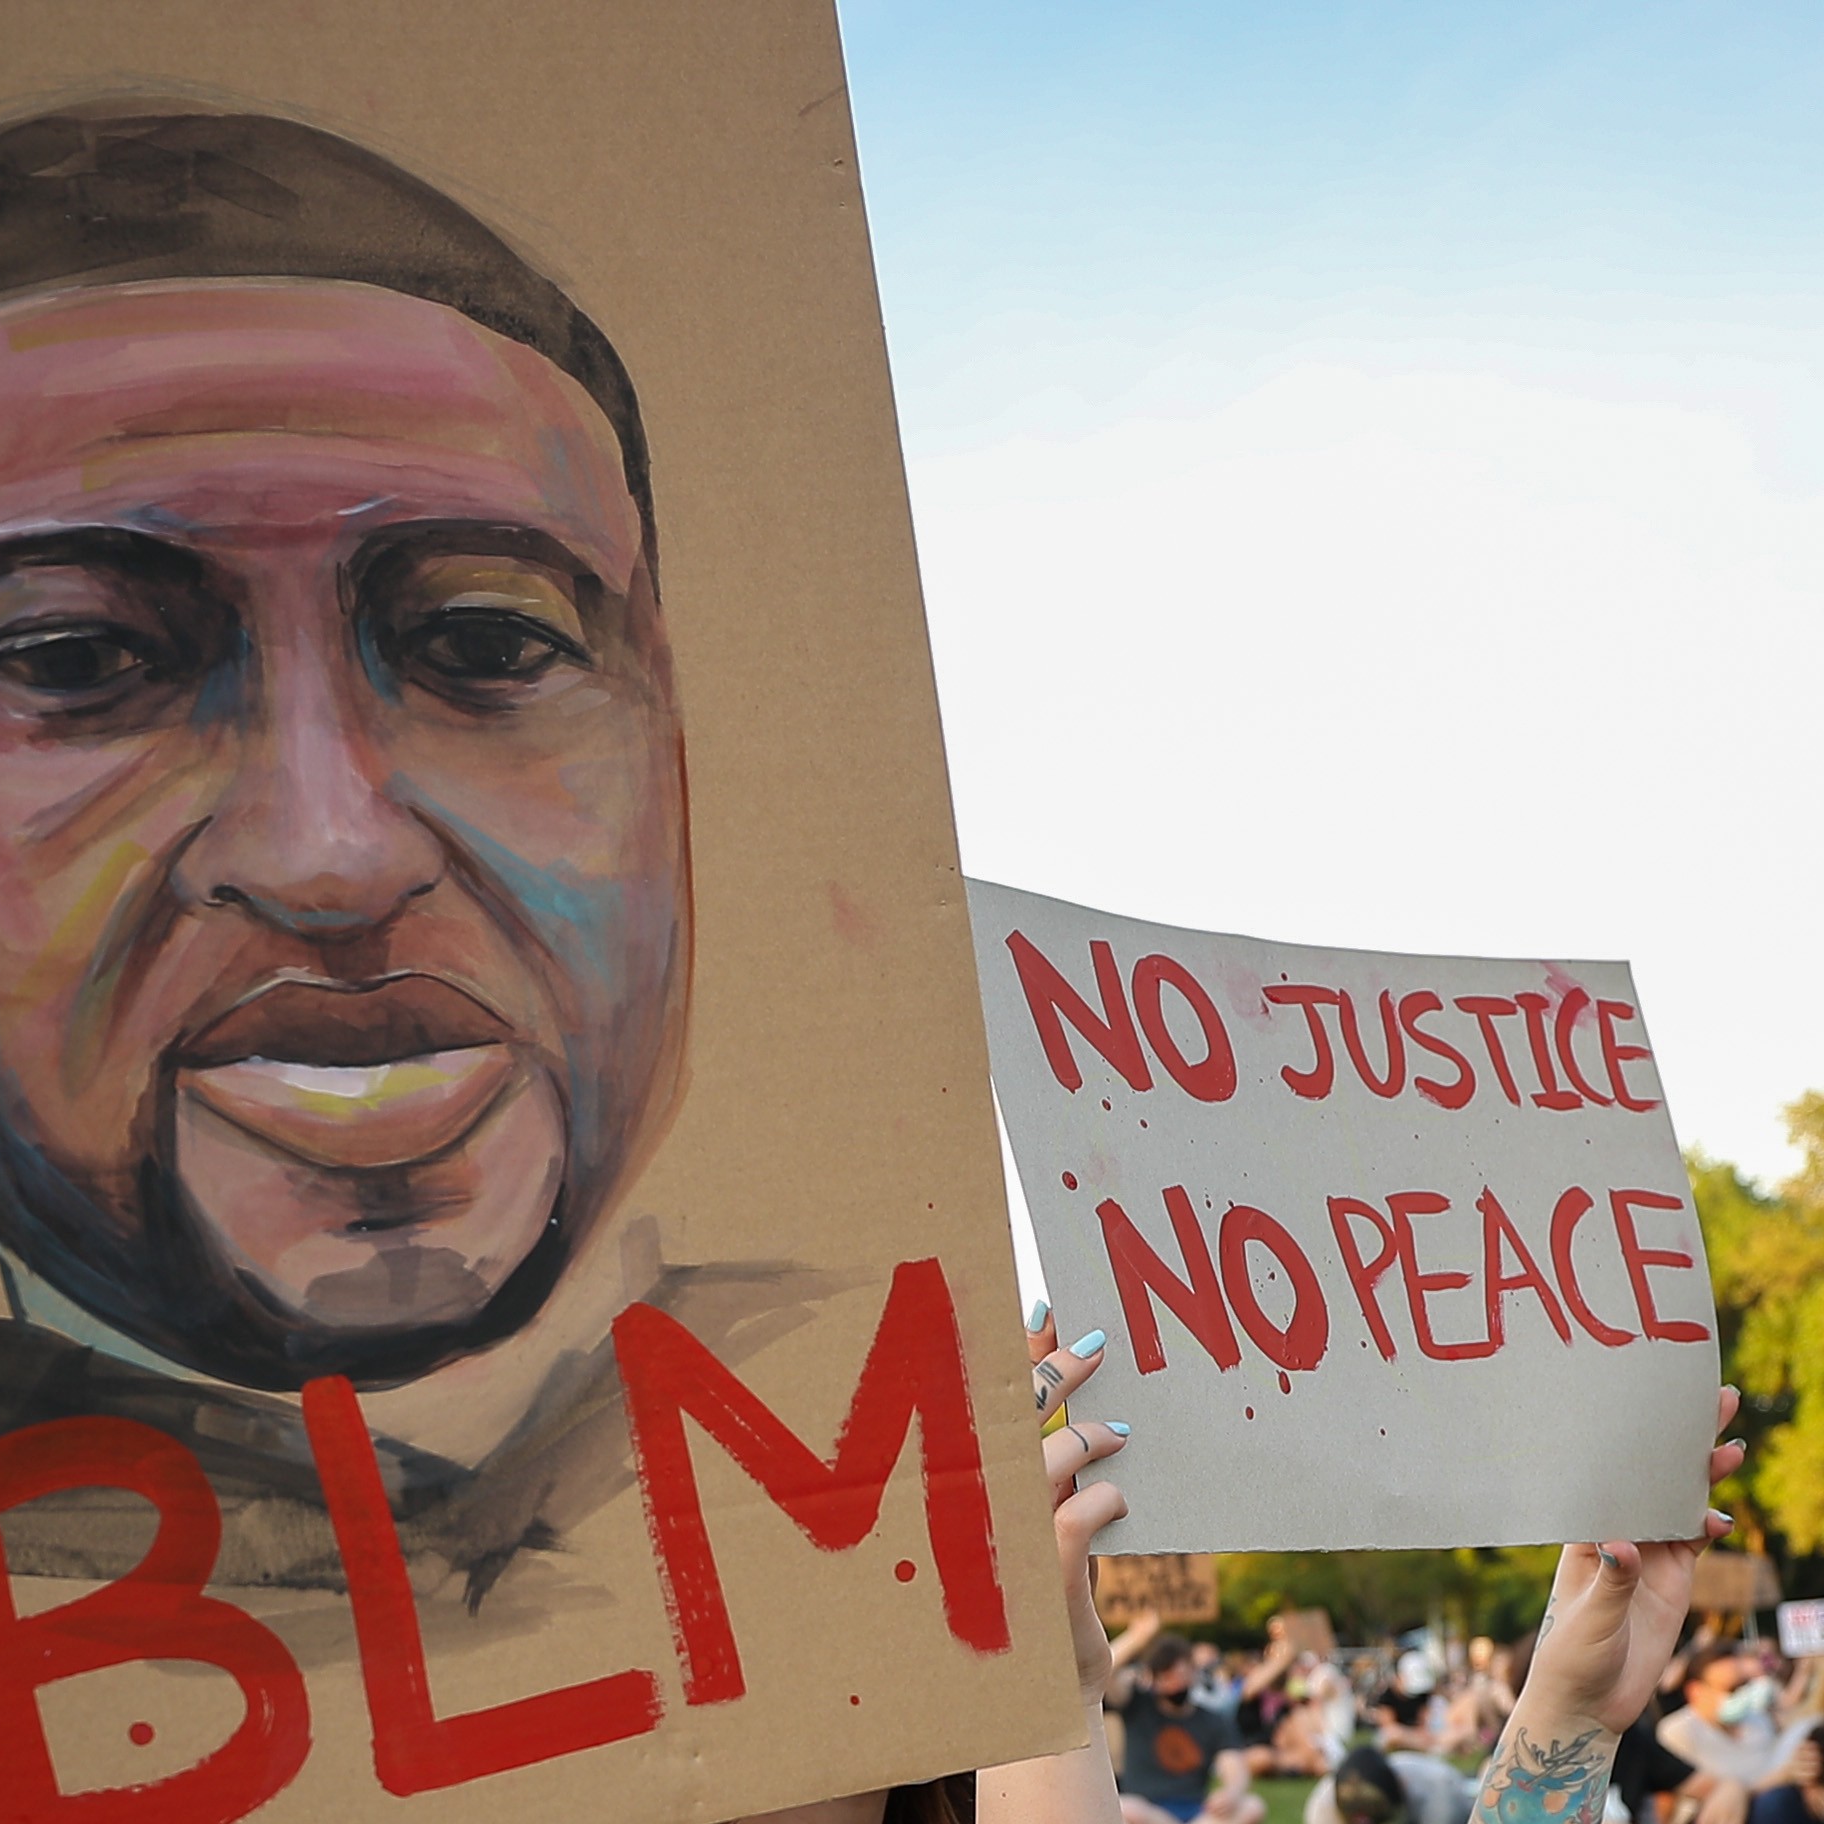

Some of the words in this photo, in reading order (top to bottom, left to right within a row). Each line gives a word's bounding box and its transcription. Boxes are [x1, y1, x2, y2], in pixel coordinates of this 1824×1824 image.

[1004, 930, 1237, 1102] NO
[1262, 986, 1663, 1112] JUSTICE
[1095, 1185, 1329, 1375] NO
[1327, 1185, 1710, 1364] PEACE
